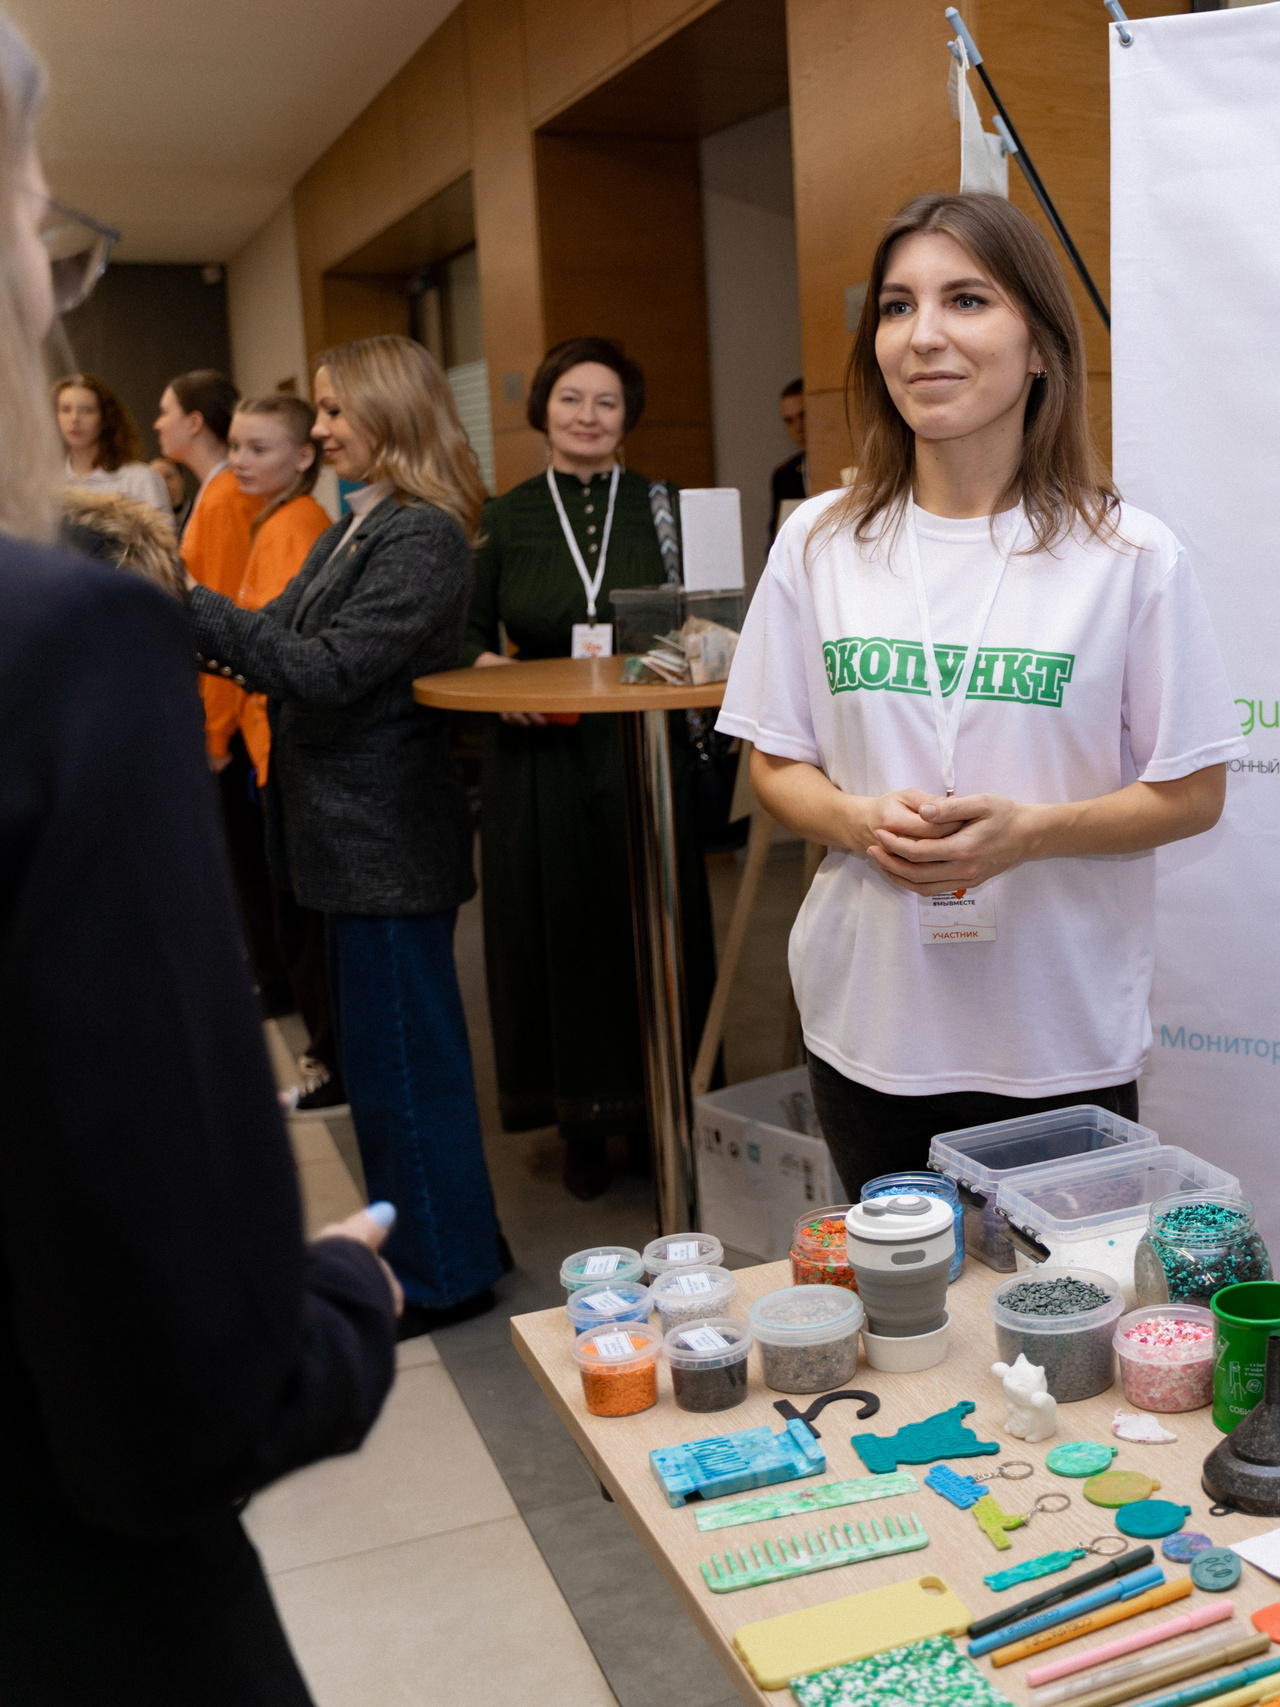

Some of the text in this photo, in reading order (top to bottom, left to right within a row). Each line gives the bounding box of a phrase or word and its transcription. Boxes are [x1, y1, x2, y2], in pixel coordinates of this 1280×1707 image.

[823, 637, 1075, 707] ЭКОПУНКТ
[932, 931, 978, 939] УЧАСТНИК
[1032, 1617, 1093, 1646] СОБИРАТОР
